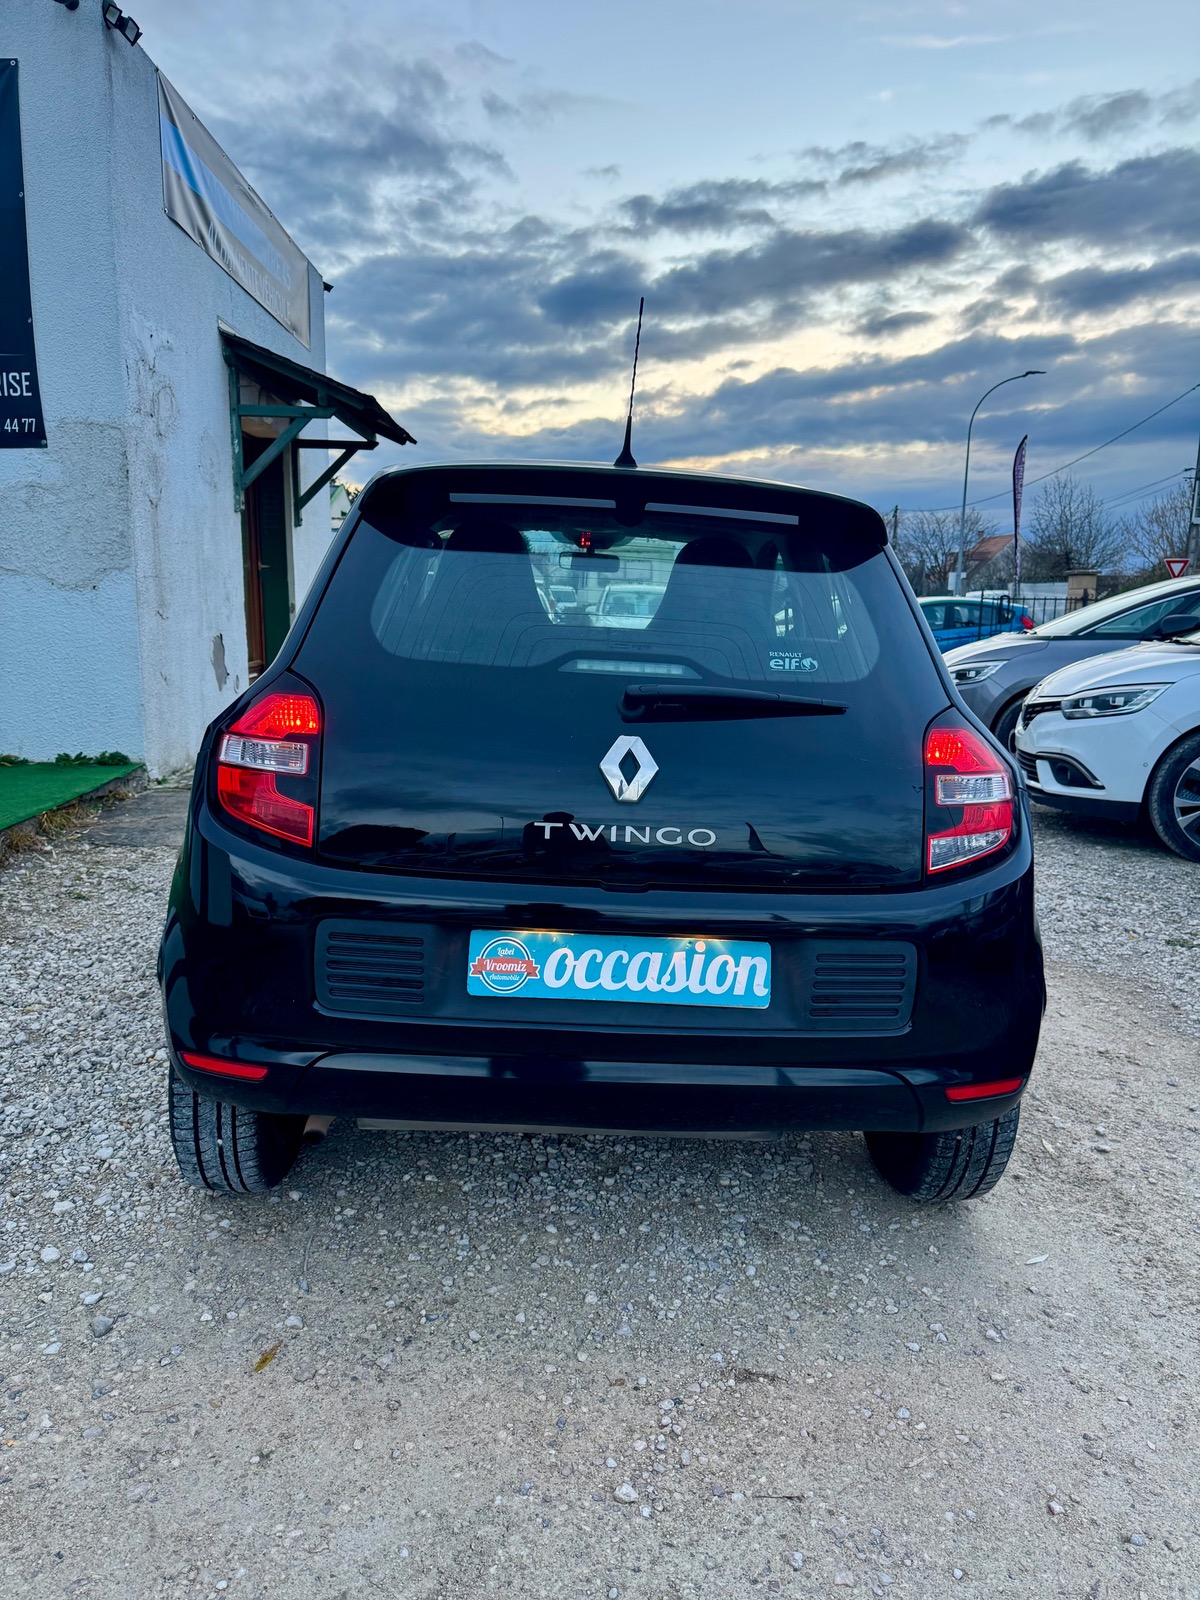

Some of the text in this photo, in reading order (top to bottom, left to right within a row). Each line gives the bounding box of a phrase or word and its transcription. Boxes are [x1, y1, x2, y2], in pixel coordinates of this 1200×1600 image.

[0, 372, 32, 396] ISE
[4, 418, 36, 432] 44 77
[770, 658, 800, 670] elf
[534, 822, 716, 846] TWINGO
[497, 947, 515, 957] Label
[484, 959, 527, 972] Vroomiz
[543, 941, 769, 997] occasion
